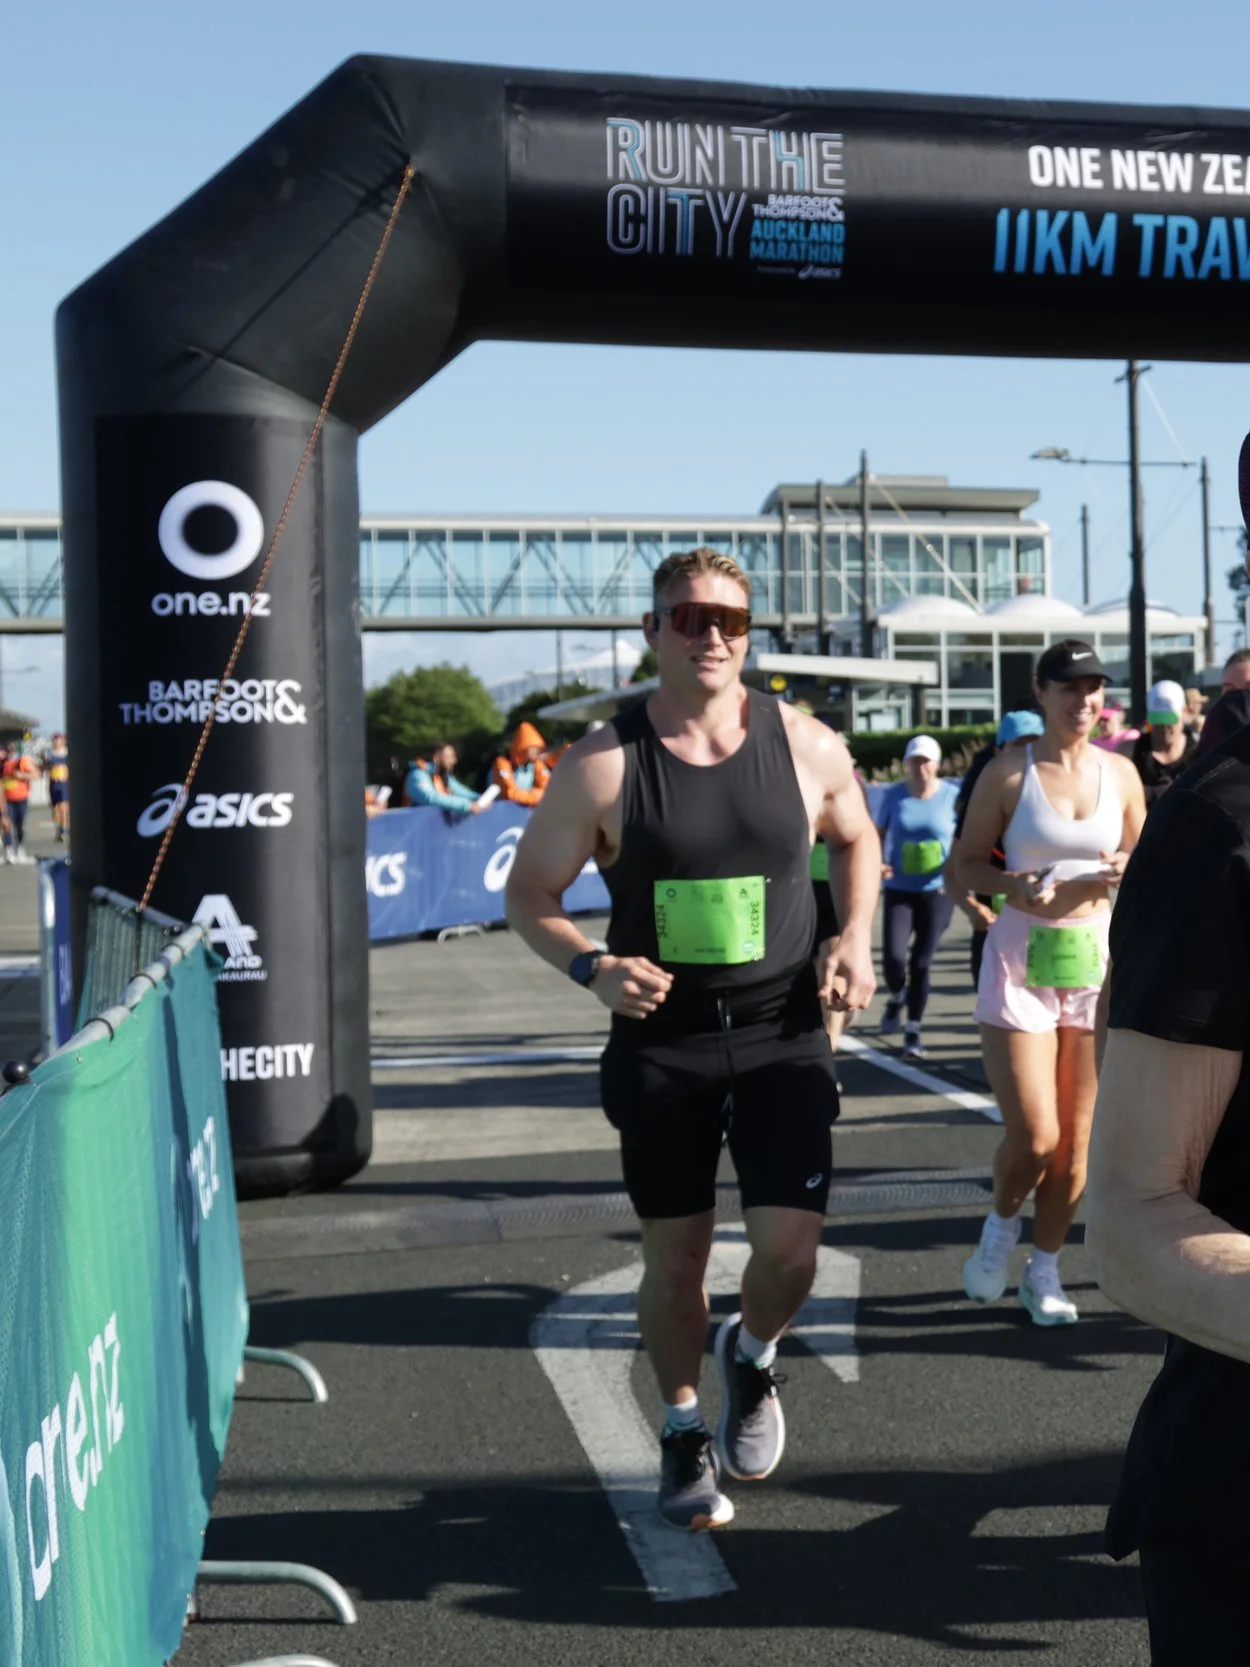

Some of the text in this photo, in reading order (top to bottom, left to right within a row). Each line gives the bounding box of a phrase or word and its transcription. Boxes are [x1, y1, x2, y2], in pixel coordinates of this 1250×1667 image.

[607, 117, 847, 195] RUN THE
[1028, 145, 1104, 189] ONE
[1111, 149, 1194, 193] NEW
[607, 183, 747, 259] CITY
[751, 219, 846, 244] AUCKLAND
[750, 241, 844, 264] MARATHON
[152, 591, 271, 617] one.nz
[149, 680, 278, 701] BARFOOT
[120, 701, 275, 724] THOMPSON
[217, 969, 268, 981] AKAURAU
[220, 1043, 315, 1081] HECITY
